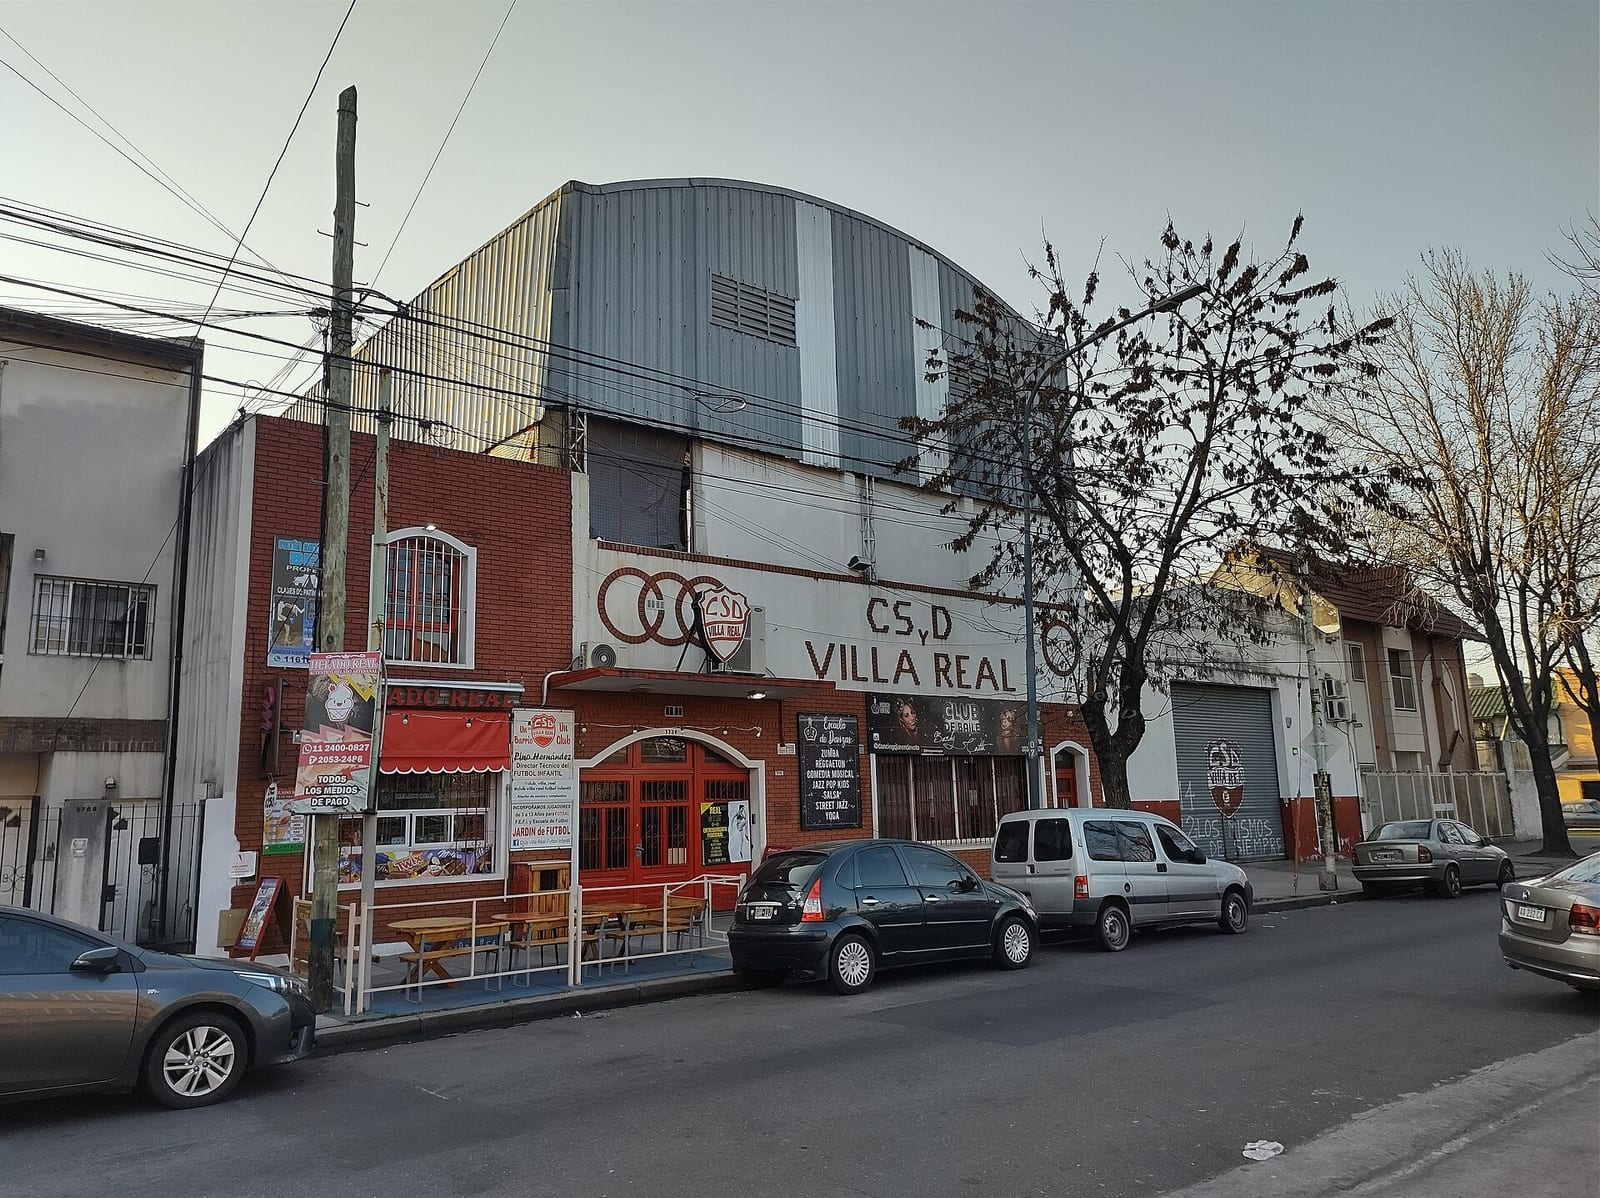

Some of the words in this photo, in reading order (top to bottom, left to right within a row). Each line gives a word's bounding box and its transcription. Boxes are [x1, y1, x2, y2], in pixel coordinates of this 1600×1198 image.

[706, 594, 743, 619] CSD
[708, 625, 724, 638] VILLA
[727, 625, 741, 637] REAL
[805, 640, 921, 686] VILLA
[934, 651, 1016, 692] REAL
[387, 687, 440, 707] ADO
[449, 688, 515, 708] REAL
[944, 702, 980, 721] CLUB
[559, 722, 568, 733] Un
[823, 716, 846, 730] Escuela
[944, 723, 956, 732] DE
[957, 723, 980, 733] BAILE
[514, 735, 533, 745] Barrio
[556, 734, 571, 745] Club
[819, 734, 828, 743] de
[324, 743, 370, 752] 2400-0827
[821, 748, 839, 758] ZUMBA
[815, 758, 846, 769] REGGAETON
[317, 775, 347, 784] TODOS
[806, 769, 831, 779] COMEDIA
[831, 769, 855, 779] MUSICAL
[305, 786, 322, 795] LOS
[323, 785, 358, 795] MEDIOS
[812, 780, 825, 789] JAZZ
[825, 780, 837, 789] POP
[837, 780, 850, 789] KIDS
[823, 790, 840, 800] SALSA
[311, 797, 324, 806] DE
[325, 796, 349, 806] PAGO
[815, 800, 835, 810] STREET
[836, 799, 849, 810] JAZZ
[825, 811, 840, 821] YOGA
[512, 827, 536, 837] JARDIN
[537, 827, 545, 836] de
[546, 825, 571, 836] FUTBOL
[1226, 818, 1274, 839] MISMOS
[1209, 840, 1225, 857] DE
